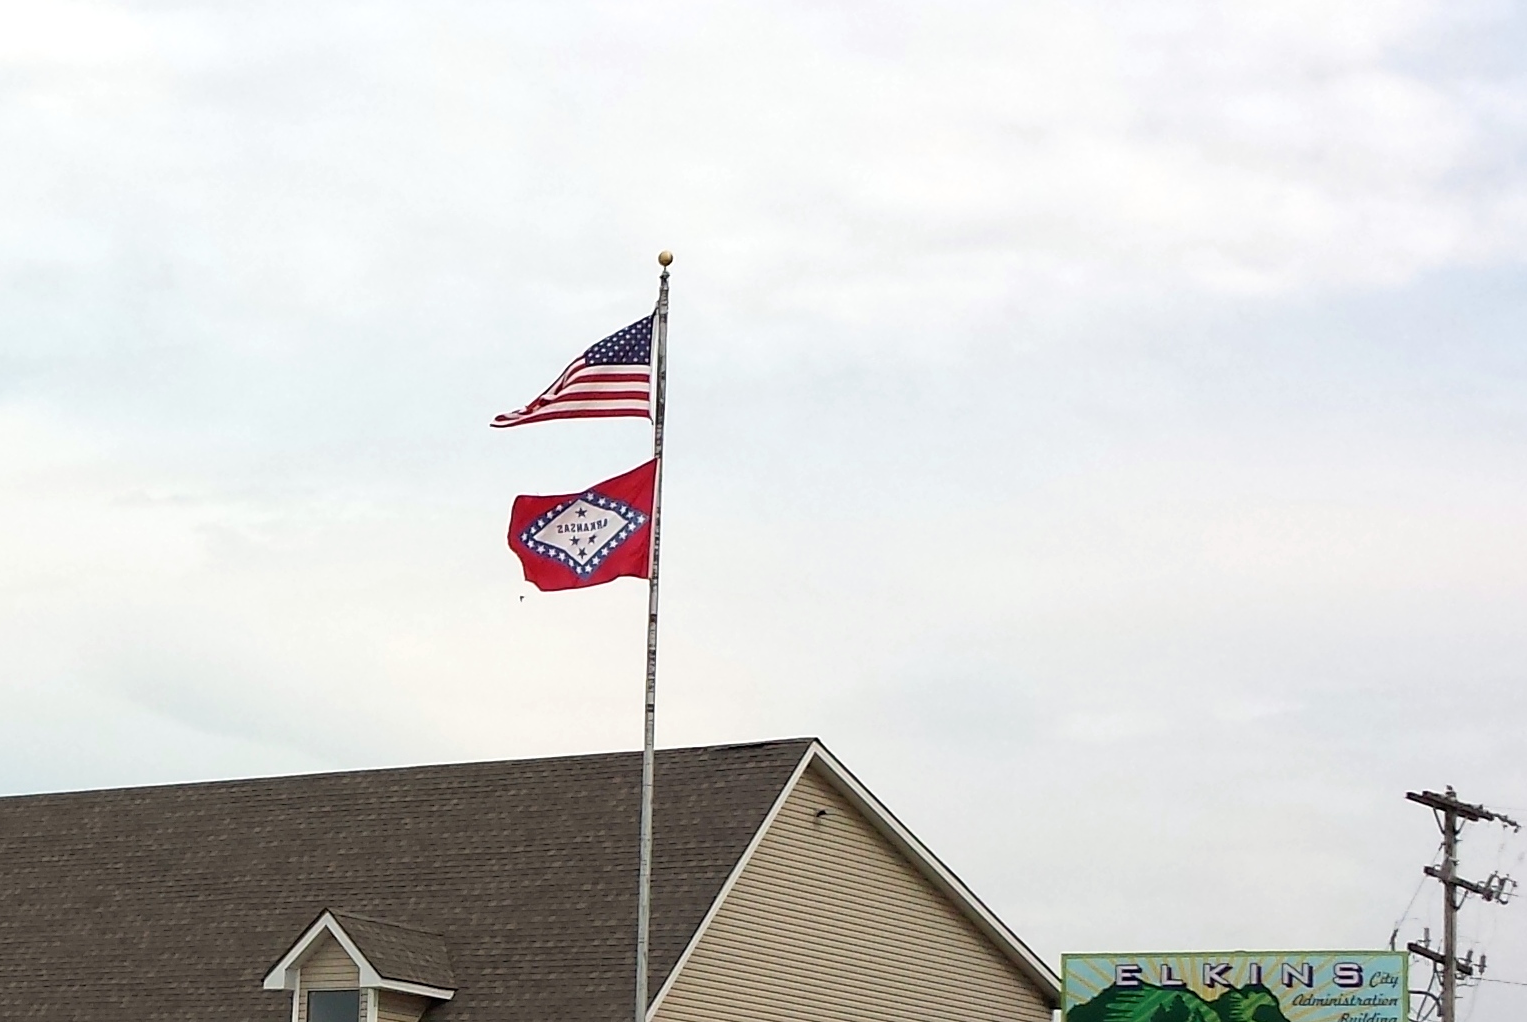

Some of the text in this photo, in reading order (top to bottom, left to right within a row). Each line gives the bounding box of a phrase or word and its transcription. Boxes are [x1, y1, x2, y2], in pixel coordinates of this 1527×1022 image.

[1115, 962, 1363, 988] ELKINS
[1369, 971, 1399, 988] City
[1292, 993, 1399, 1007] Administration
